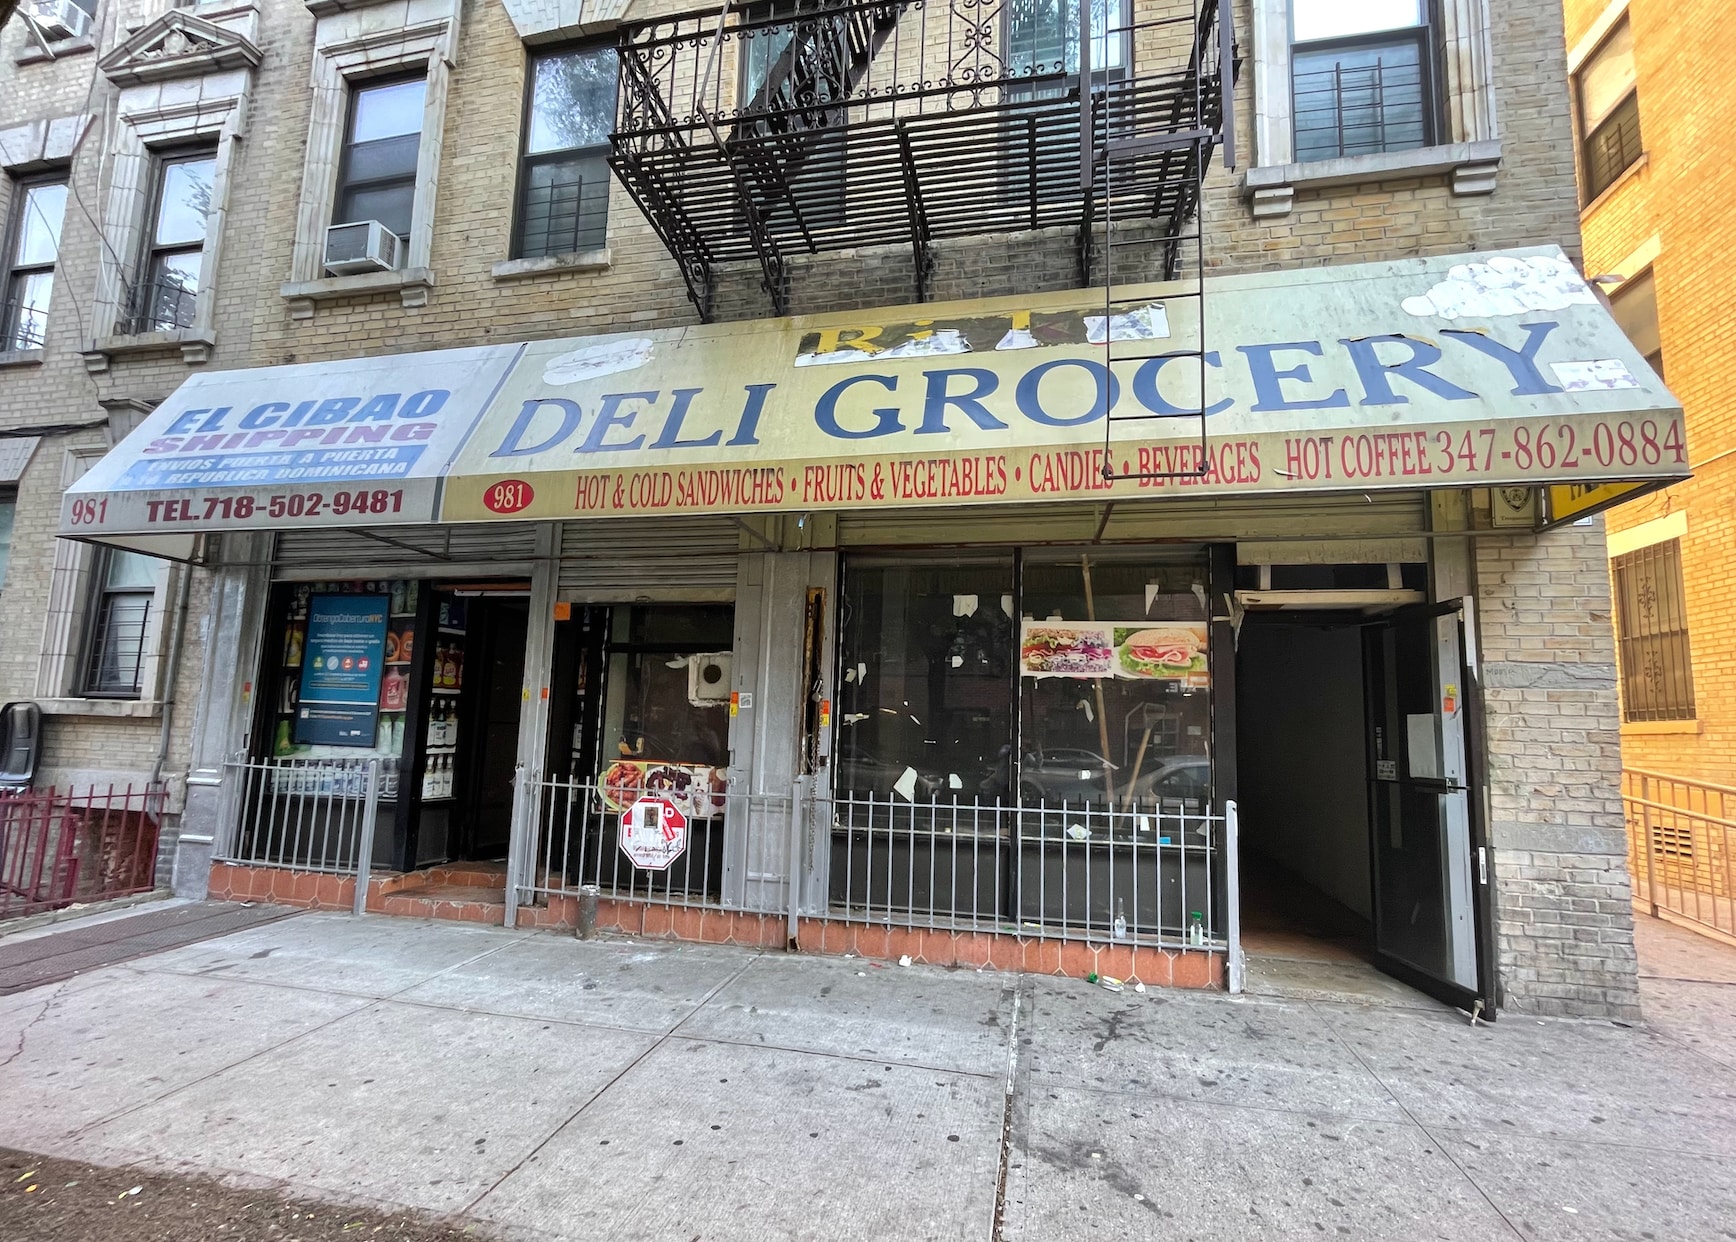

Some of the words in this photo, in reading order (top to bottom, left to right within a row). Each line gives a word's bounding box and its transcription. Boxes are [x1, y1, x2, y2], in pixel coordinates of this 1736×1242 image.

[488, 383, 778, 458] DELI
[814, 321, 1564, 439] GROCERY
[162, 407, 225, 436] EL
[238, 389, 452, 430] CIBAO
[142, 422, 438, 455] SHIPPING
[1436, 419, 1686, 474] 347-862-0884
[149, 458, 213, 473] ENVIOS
[217, 453, 293, 469] PUERTA
[298, 451, 315, 463] A
[320, 447, 400, 462] PUERTA
[166, 467, 273, 484] REPUBLICA
[274, 462, 408, 479] DOMINICANA
[574, 474, 610, 510] HOT
[612, 473, 625, 509] &
[630, 471, 673, 508] COLD
[676, 467, 784, 507] SANDWICHES
[803, 463, 865, 502] FRUITS
[870, 462, 885, 500] &
[890, 455, 1007, 499] VEGETABLES
[1028, 449, 1114, 493] CANDIES
[1138, 440, 1261, 488] BEVERAGES
[1285, 436, 1334, 481] HOT
[1341, 430, 1432, 478] COFFEE
[71, 497, 108, 526] 981
[493, 484, 526, 509] 981
